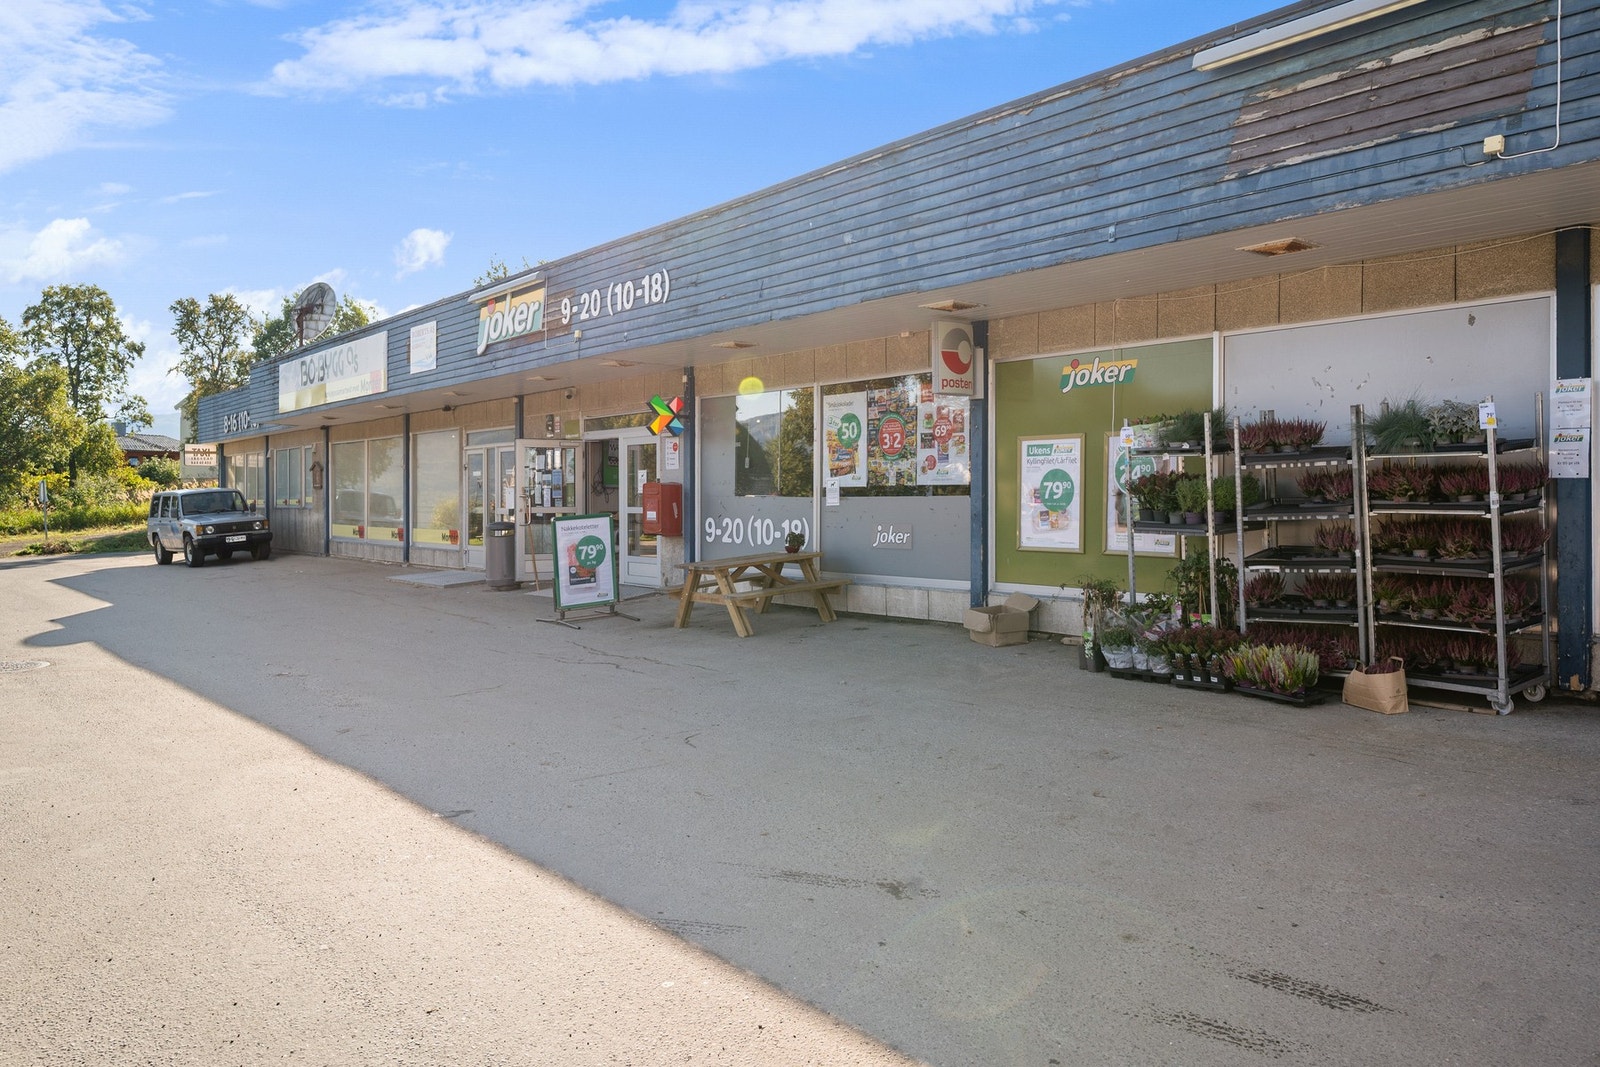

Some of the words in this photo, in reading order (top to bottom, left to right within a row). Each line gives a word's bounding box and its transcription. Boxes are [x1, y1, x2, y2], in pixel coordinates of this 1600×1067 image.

[561, 289, 601, 325] 9-20
[607, 268, 671, 316] (10-18)
[477, 291, 541, 356] joker
[941, 376, 973, 390] posten
[1062, 356, 1132, 394] joker
[1556, 384, 1585, 393] joker
[841, 421, 858, 440] 50
[1554, 433, 1584, 443] joker
[882, 433, 890, 449] 3
[893, 432, 901, 448] 2
[192, 447, 211, 457] TAXI
[1028, 446, 1051, 455] Ukens
[705, 517, 744, 545] 9-20
[873, 525, 911, 547] joker
